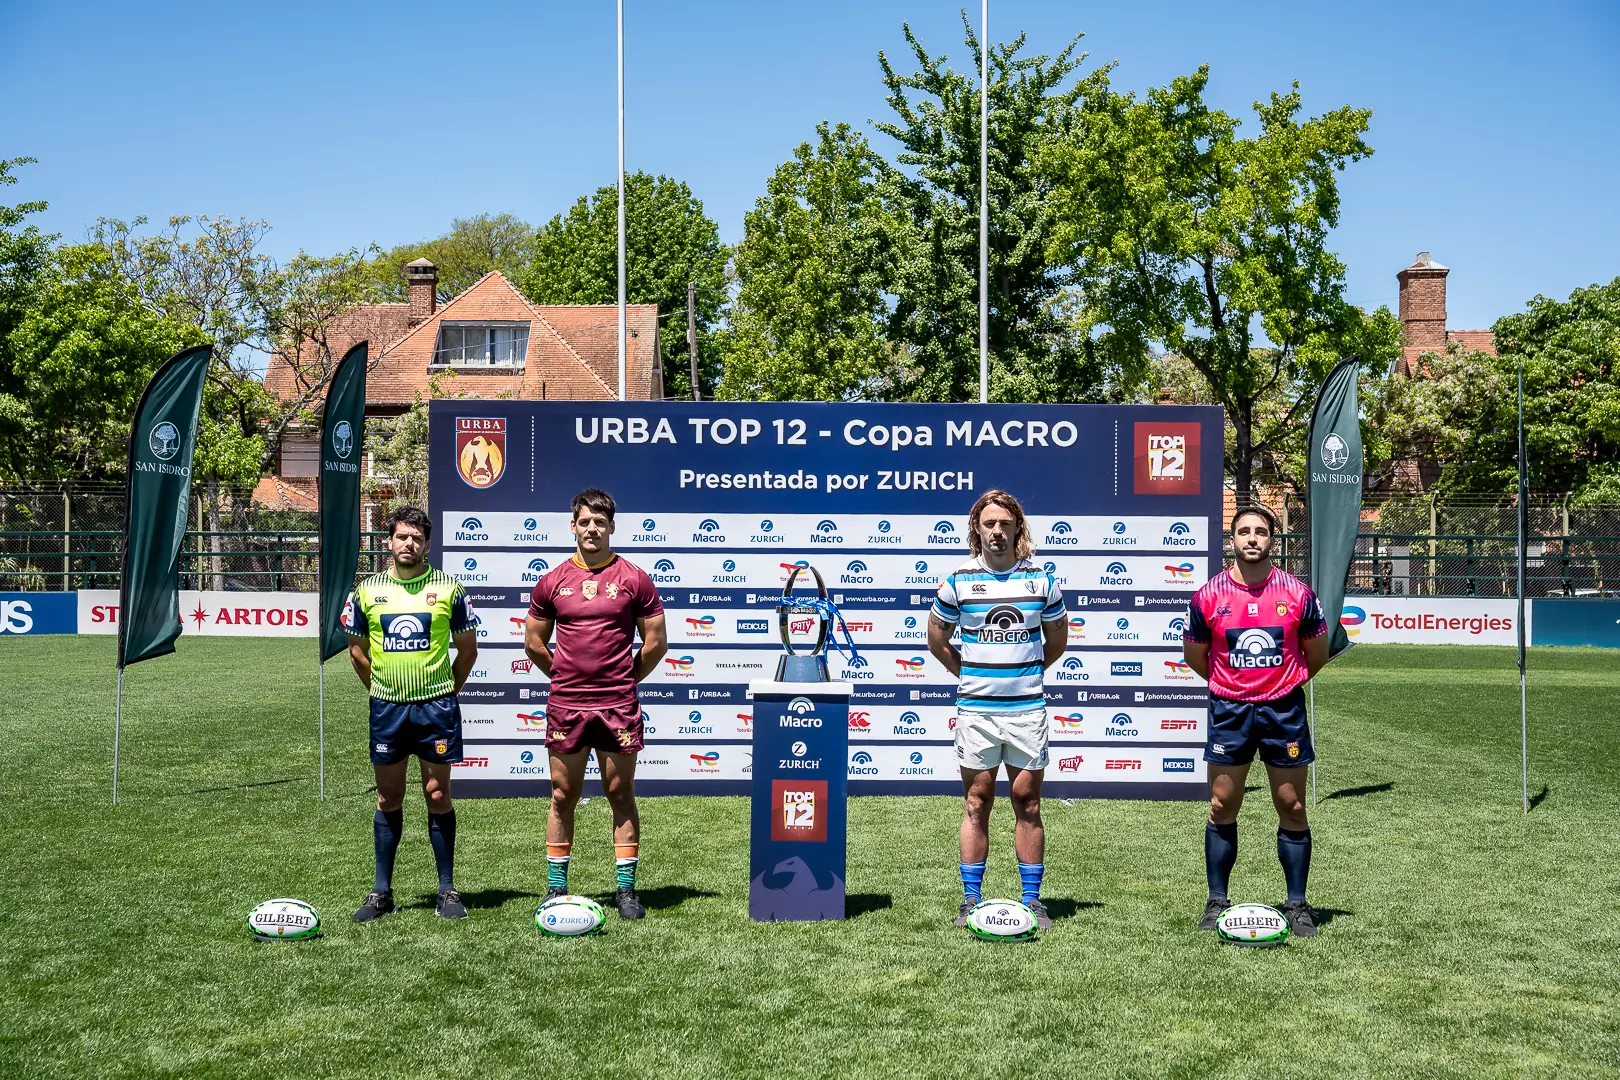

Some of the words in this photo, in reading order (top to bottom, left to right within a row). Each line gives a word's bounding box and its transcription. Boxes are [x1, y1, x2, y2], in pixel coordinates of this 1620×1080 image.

[461, 419, 501, 430] URBA
[575, 417, 677, 444] URBA
[688, 418, 762, 445] TOP
[772, 418, 807, 445] 12
[843, 419, 932, 451] Copa
[946, 420, 1078, 447] MACRO
[1150, 436, 1184, 448] TOP
[324, 460, 338, 471] SAN
[1150, 450, 1184, 476] 12
[136, 460, 156, 472] SAN
[158, 464, 190, 476] ISIDRO
[680, 469, 818, 489] Presentada
[826, 473, 869, 493] por
[876, 470, 974, 490] ZURICH
[1312, 472, 1327, 482] SAN
[1329, 474, 1360, 484] ISIDRO
[455, 532, 488, 541] Macro
[632, 534, 666, 542] ZURICH
[692, 534, 726, 543] Macro
[810, 534, 843, 543] Macro
[928, 535, 960, 544] Macro
[1045, 536, 1078, 545] Macro
[1163, 537, 1196, 546] Macro
[454, 574, 488, 582] ZURICH
[649, 573, 680, 582] Macro
[840, 575, 873, 584] Macro
[1100, 576, 1133, 585] Macro
[215, 607, 308, 627] ARTOIS
[738, 622, 767, 630] MEDICUS
[792, 621, 810, 629] PATY
[1370, 613, 1512, 635] TotalEnergies
[978, 628, 1029, 643] Macro
[383, 636, 429, 650] Macro
[513, 659, 532, 669] PATY
[1230, 653, 1283, 668] Macro
[841, 670, 874, 679] Macro
[1056, 672, 1089, 680] Macro
[779, 715, 823, 728] Macro
[1161, 720, 1197, 730] ESPN
[894, 726, 926, 735] Macro
[1105, 728, 1138, 737] Macro
[779, 760, 819, 769] ZURICH
[1061, 758, 1079, 767] PATY
[1105, 760, 1141, 769] ESPN
[1164, 761, 1193, 769] MEDICUS
[848, 766, 878, 775] Macro
[785, 792, 814, 802] TOP
[784, 804, 814, 826] 12
[255, 914, 312, 925] GILBERT
[985, 916, 1020, 926] Macro
[1224, 917, 1280, 927] GILBERT
